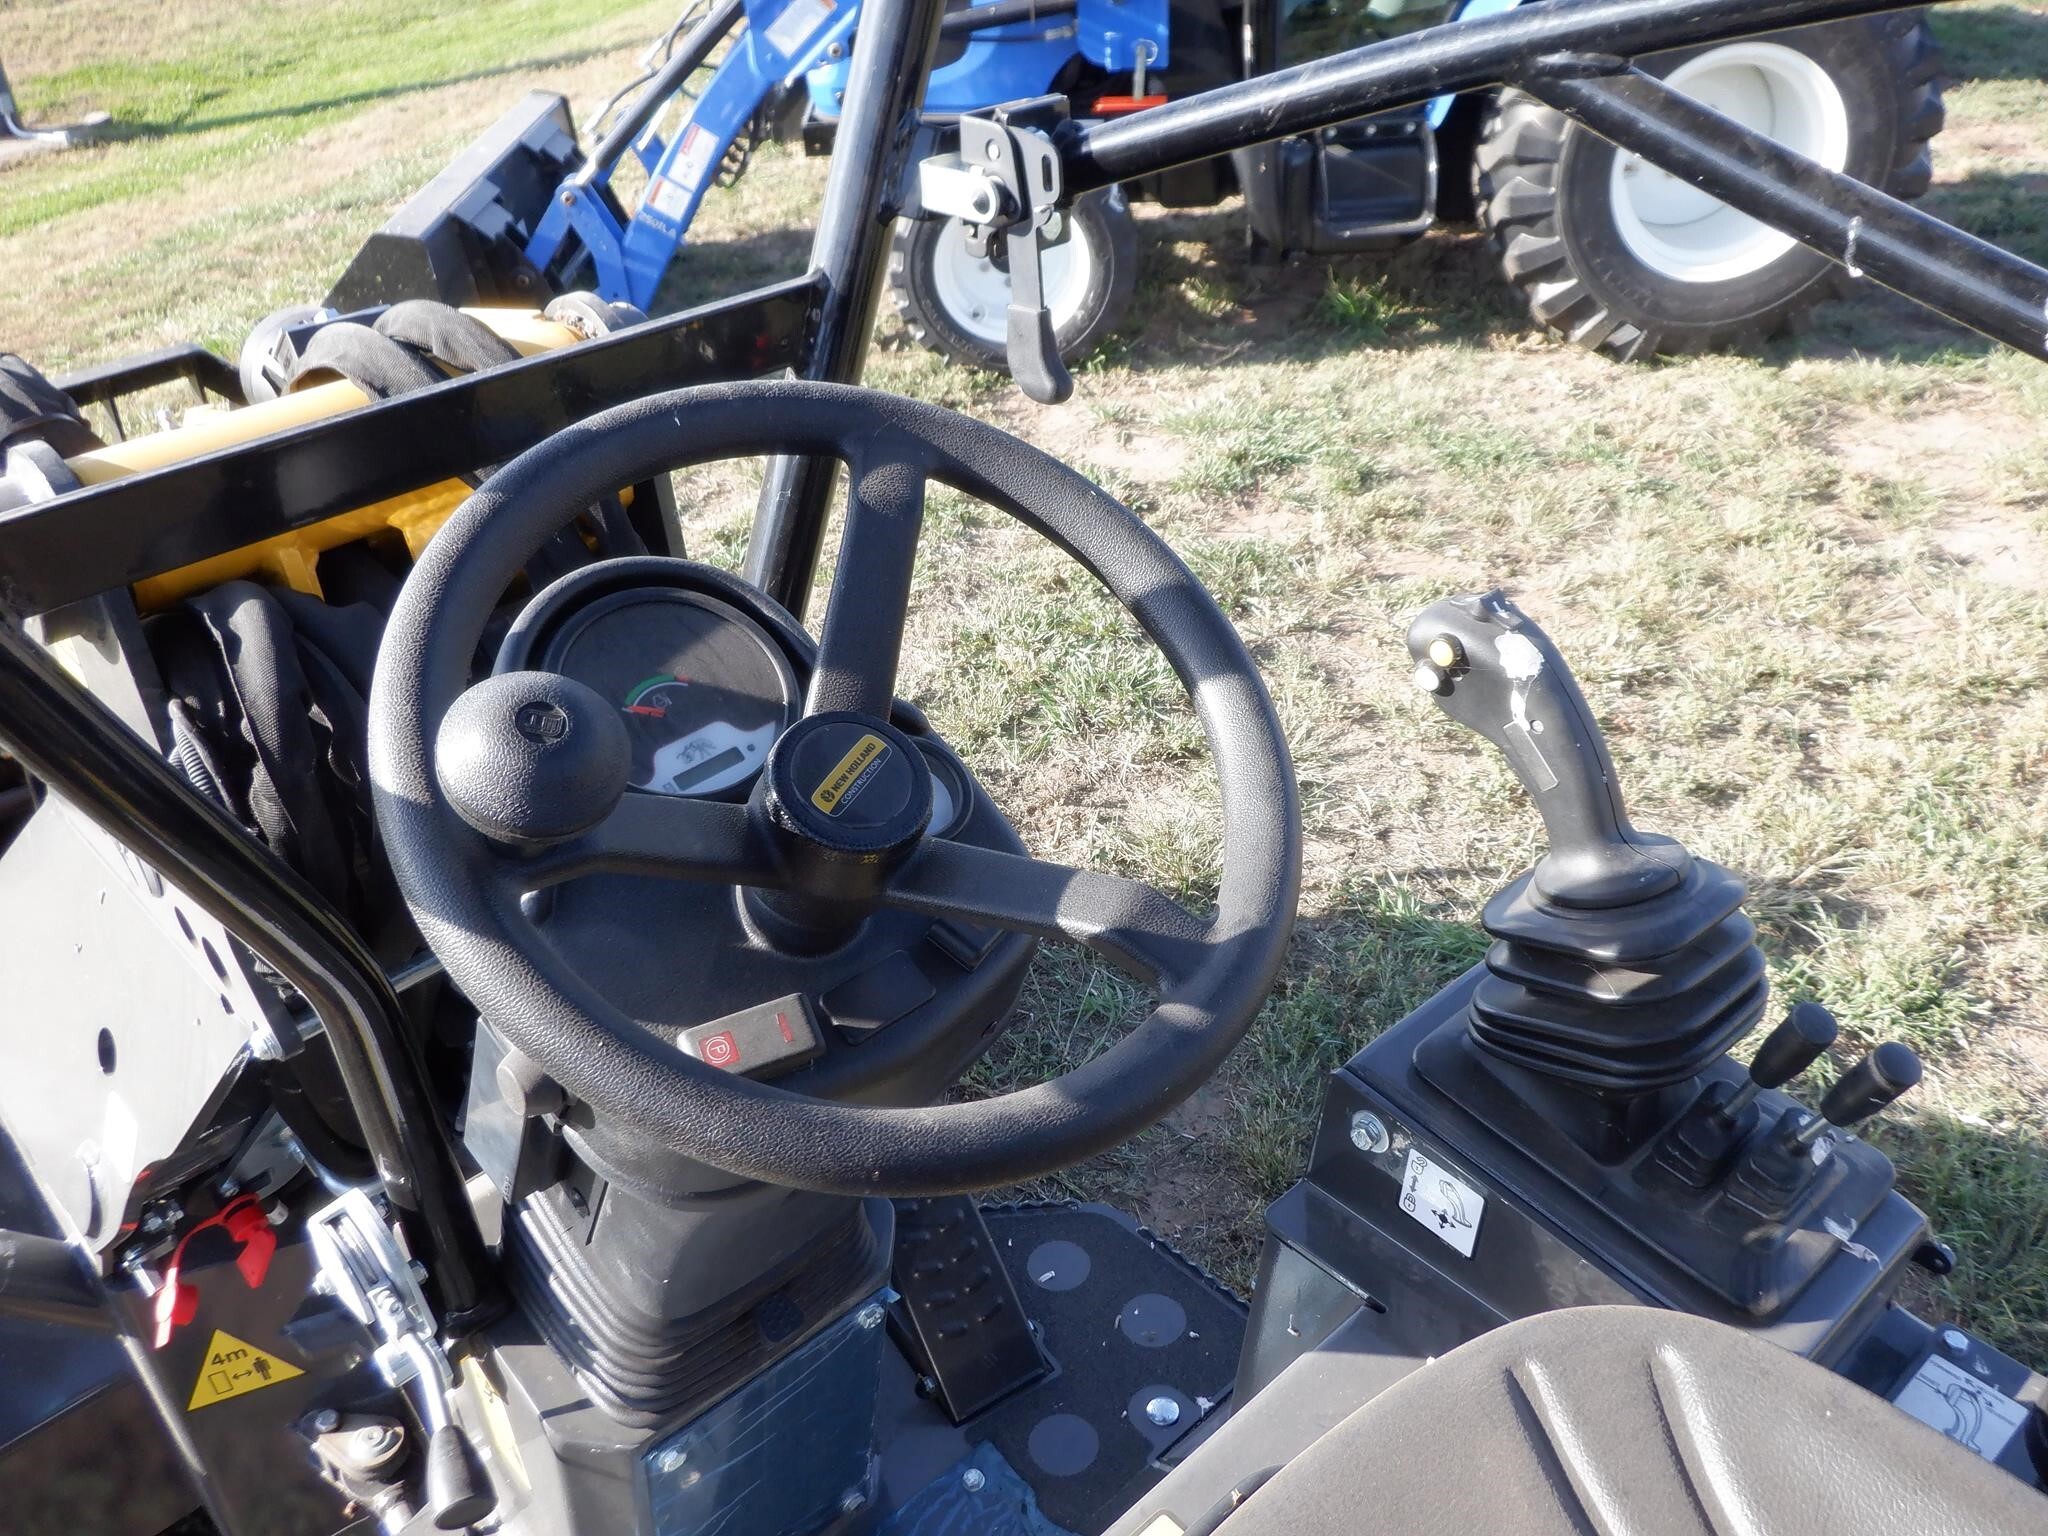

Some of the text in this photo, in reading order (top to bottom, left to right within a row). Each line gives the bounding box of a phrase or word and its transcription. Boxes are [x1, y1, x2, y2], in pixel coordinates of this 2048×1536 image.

[831, 743, 876, 792] NEW HOLLAND
[841, 758, 882, 804] CONSTRUCTION
[211, 1348, 249, 1365] 4m
